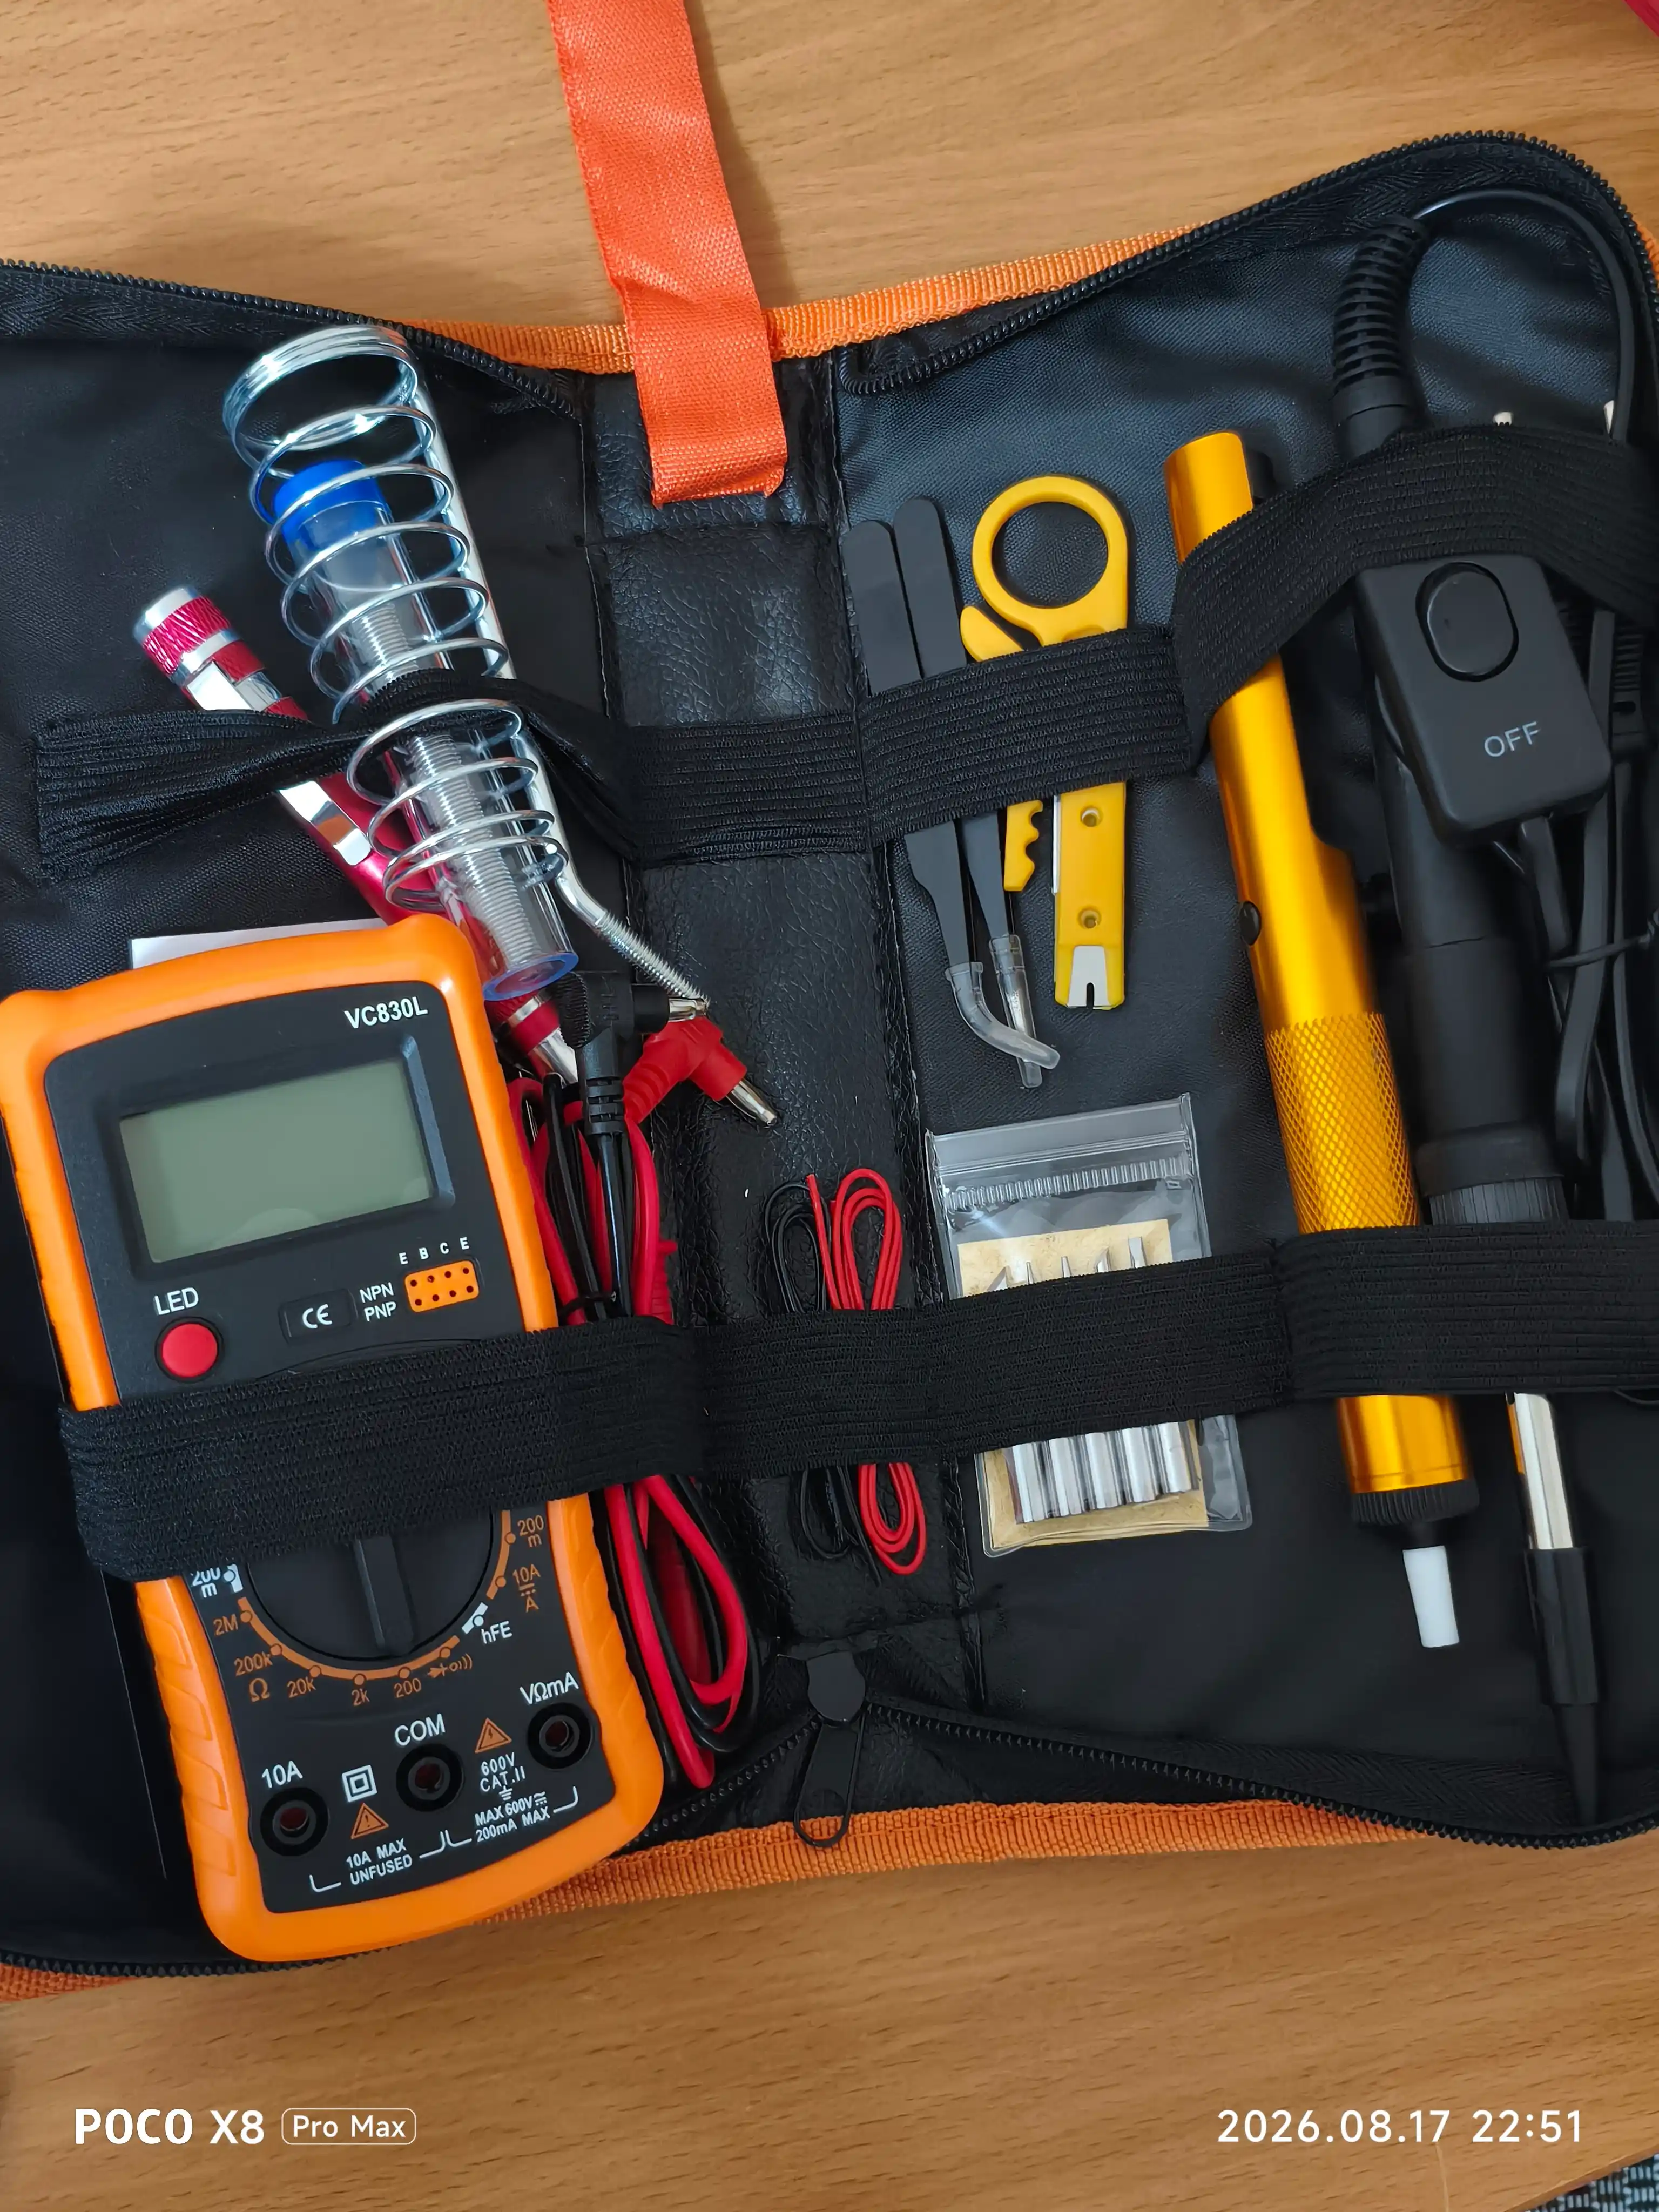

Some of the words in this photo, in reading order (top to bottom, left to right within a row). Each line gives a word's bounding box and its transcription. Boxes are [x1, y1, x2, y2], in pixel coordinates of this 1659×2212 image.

[1484, 721, 1541, 757] OFF
[344, 997, 428, 1028] VC830L
[399, 1252, 408, 1264] E
[419, 1247, 429, 1259] B
[440, 1242, 449, 1254] C
[460, 1237, 469, 1250] E
[154, 1287, 199, 1316] LED
[359, 1282, 394, 1303] NPN
[364, 1301, 396, 1321] PNP
[517, 1515, 544, 1536] 200
[528, 1534, 542, 1547] m
[512, 1564, 541, 1584] 10A
[201, 1582, 217, 1598] m
[525, 1596, 539, 1613] A
[213, 1614, 238, 1636] 2M
[481, 1621, 512, 1644] hFE
[234, 1651, 273, 1676] 200k
[287, 1676, 316, 1698] 20k
[351, 1688, 370, 1706] 2k
[394, 1677, 421, 1698] 200
[519, 1671, 579, 1705] VΩmA
[394, 1713, 446, 1745] COM
[261, 1761, 304, 1788] 10A
[481, 1752, 515, 1776] 600V
[475, 1805, 504, 1826] MAX
[476, 1818, 517, 1843] 200mA
[521, 1806, 550, 1826] MAX
[346, 1851, 372, 1869] 10A
[376, 1838, 407, 1859] MAX
[350, 1854, 412, 1885] UNFUSED
